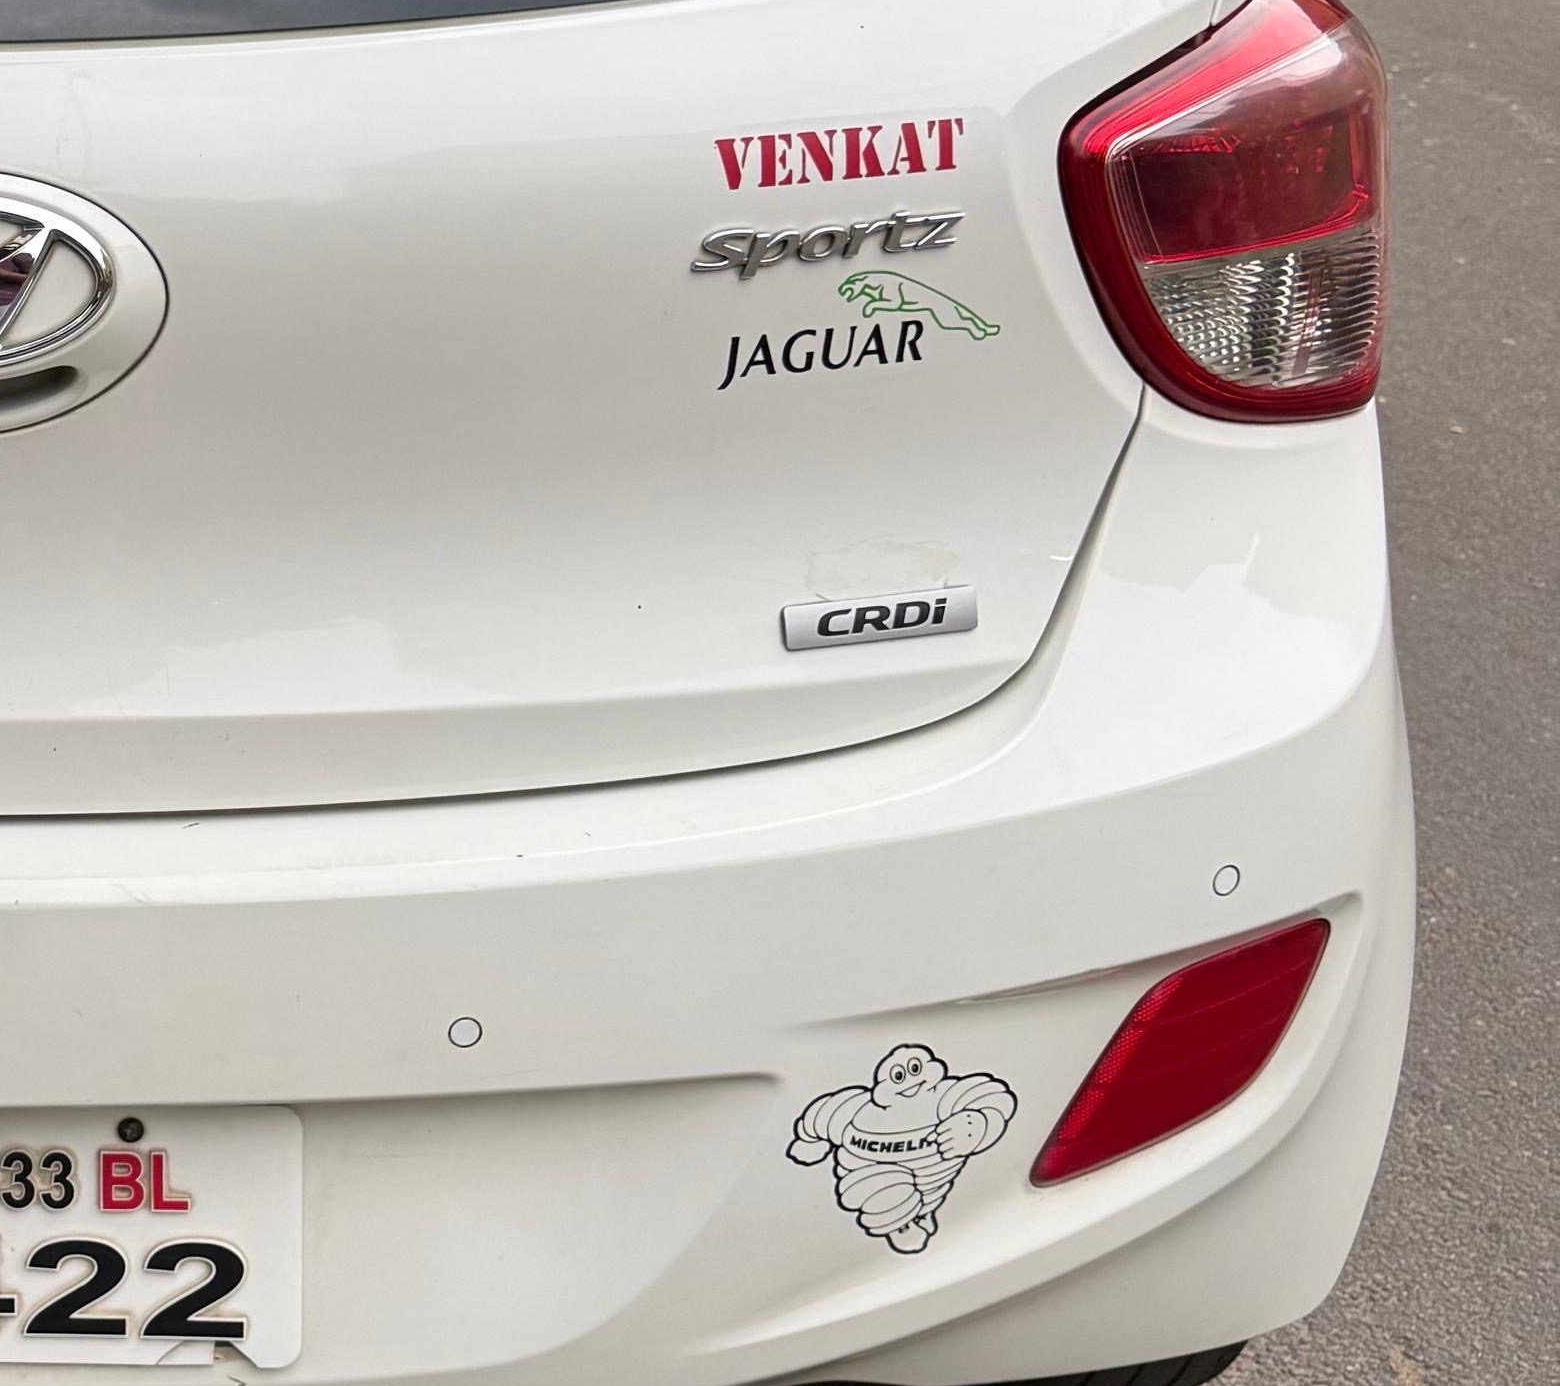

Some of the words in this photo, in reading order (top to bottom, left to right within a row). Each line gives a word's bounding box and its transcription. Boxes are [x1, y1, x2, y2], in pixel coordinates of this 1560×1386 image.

[713, 117, 964, 191] VENKAT
[715, 319, 924, 391] JAGUAR
[817, 597, 948, 637] CRDi
[0, 1148, 77, 1211] 33
[98, 1149, 192, 1213] BL
